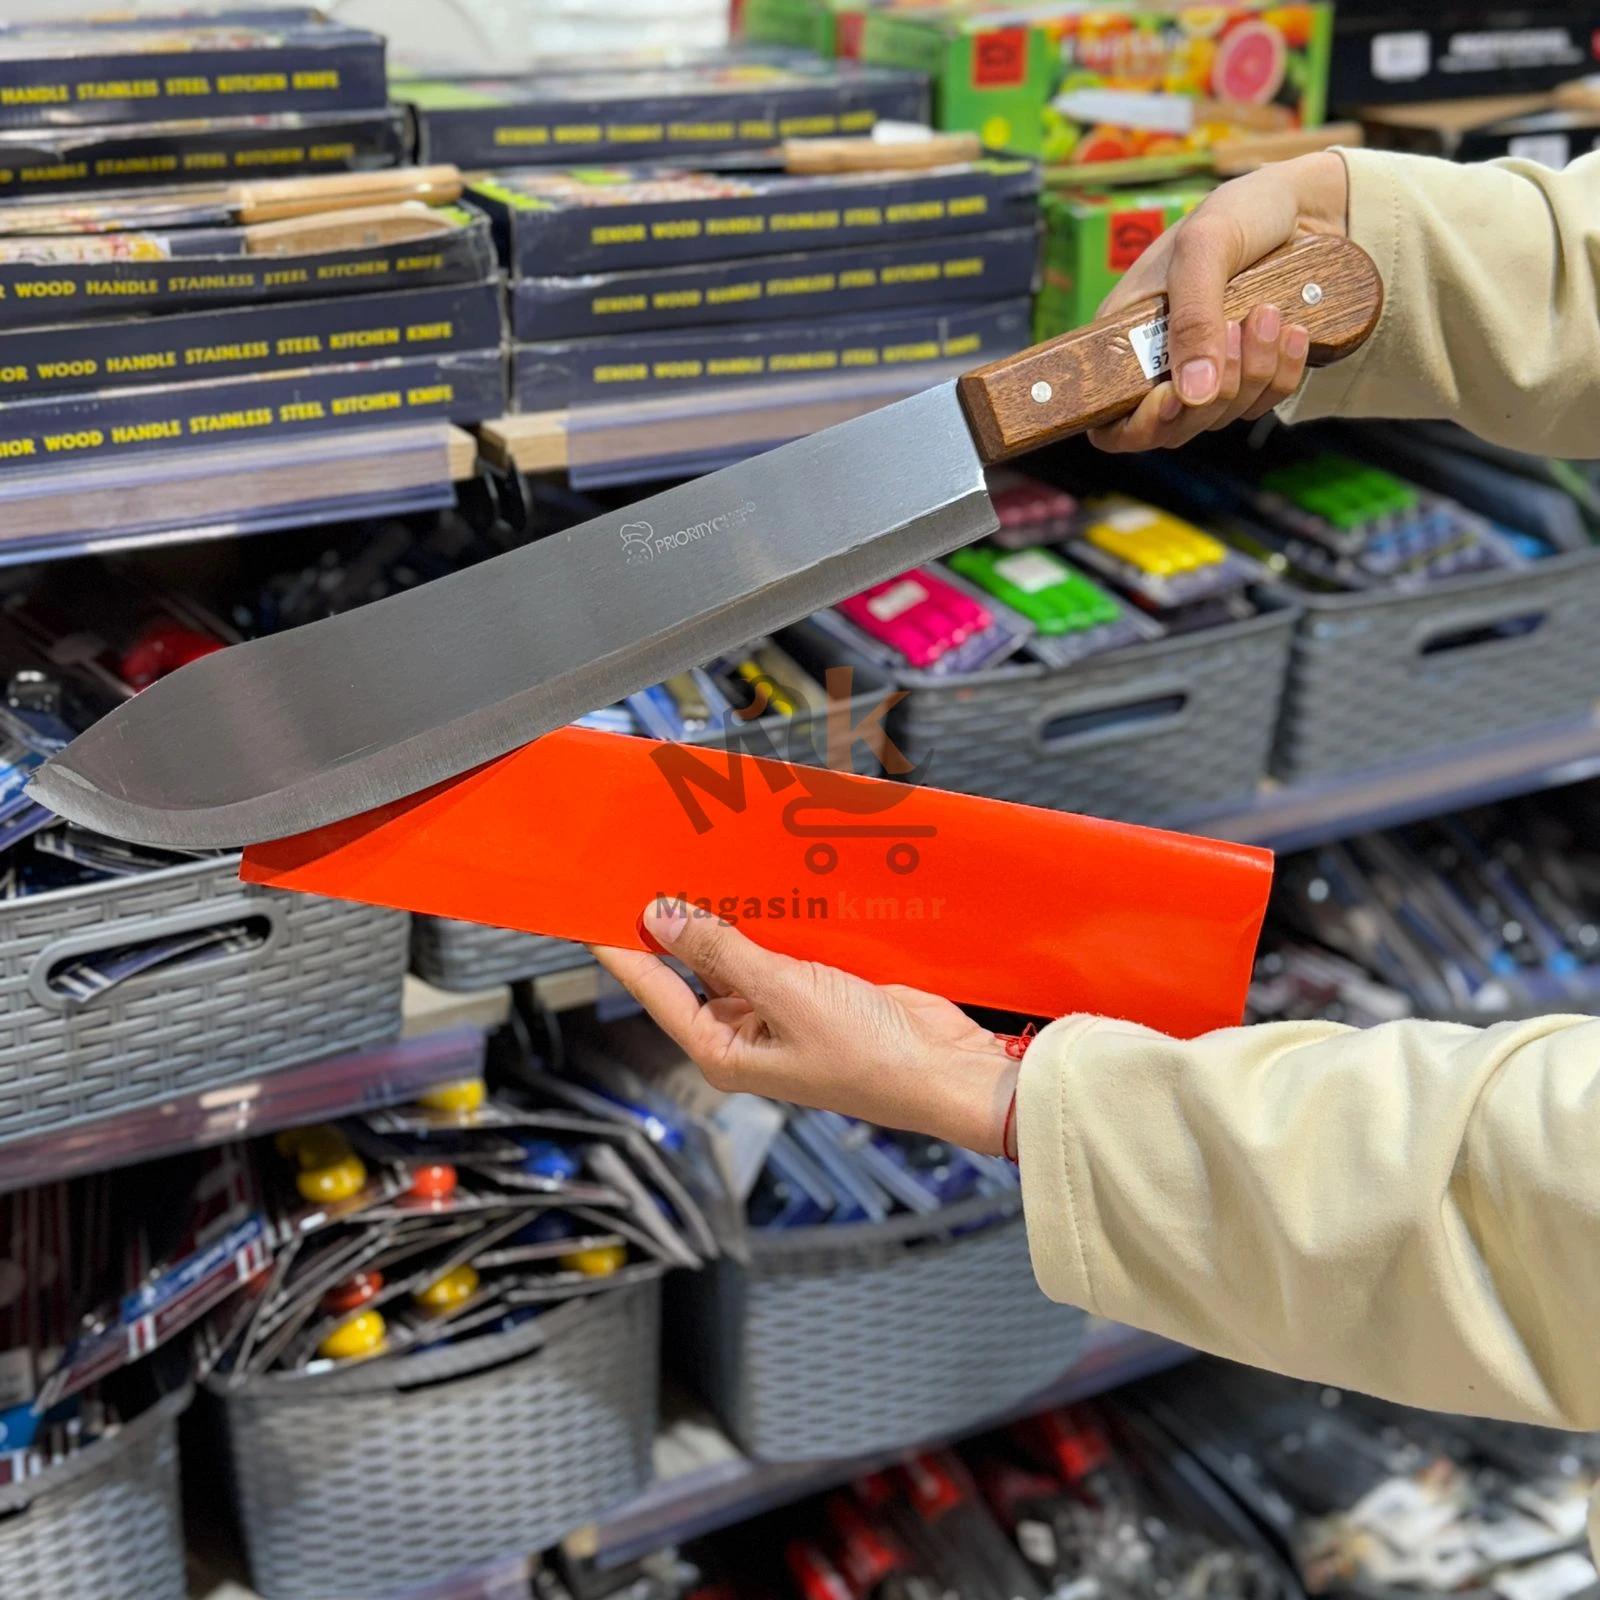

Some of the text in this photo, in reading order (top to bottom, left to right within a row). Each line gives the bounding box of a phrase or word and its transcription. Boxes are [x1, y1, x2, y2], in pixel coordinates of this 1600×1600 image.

[77, 82, 158, 99] STAINLESS
[166, 78, 209, 96] STEEL
[217, 74, 287, 93] KITCHEN
[292, 71, 339, 91] KNIFE
[95, 155, 176, 175] STAINLESS
[14, 281, 76, 298] WOOD
[86, 279, 157, 295] HANDLE
[168, 273, 255, 292] STAINLESS
[263, 268, 308, 286] STEEL
[317, 260, 388, 279] KITCHEN
[396, 254, 443, 272] KNIFE
[37, 361, 97, 379] WOOD
[106, 352, 176, 372] HANDLE
[185, 342, 268, 364] STAINLESS
[277, 337, 321, 354] STEEL
[330, 327, 399, 348] KITCHEN
[406, 323, 453, 341] KNIFE
[44, 431, 103, 452] WOOD
[111, 421, 180, 443] HANDLE
[189, 410, 272, 433] STAINLESS
[280, 403, 323, 421] STEEL
[331, 393, 401, 415] KITCHEN
[406, 386, 453, 405] KNIFE
